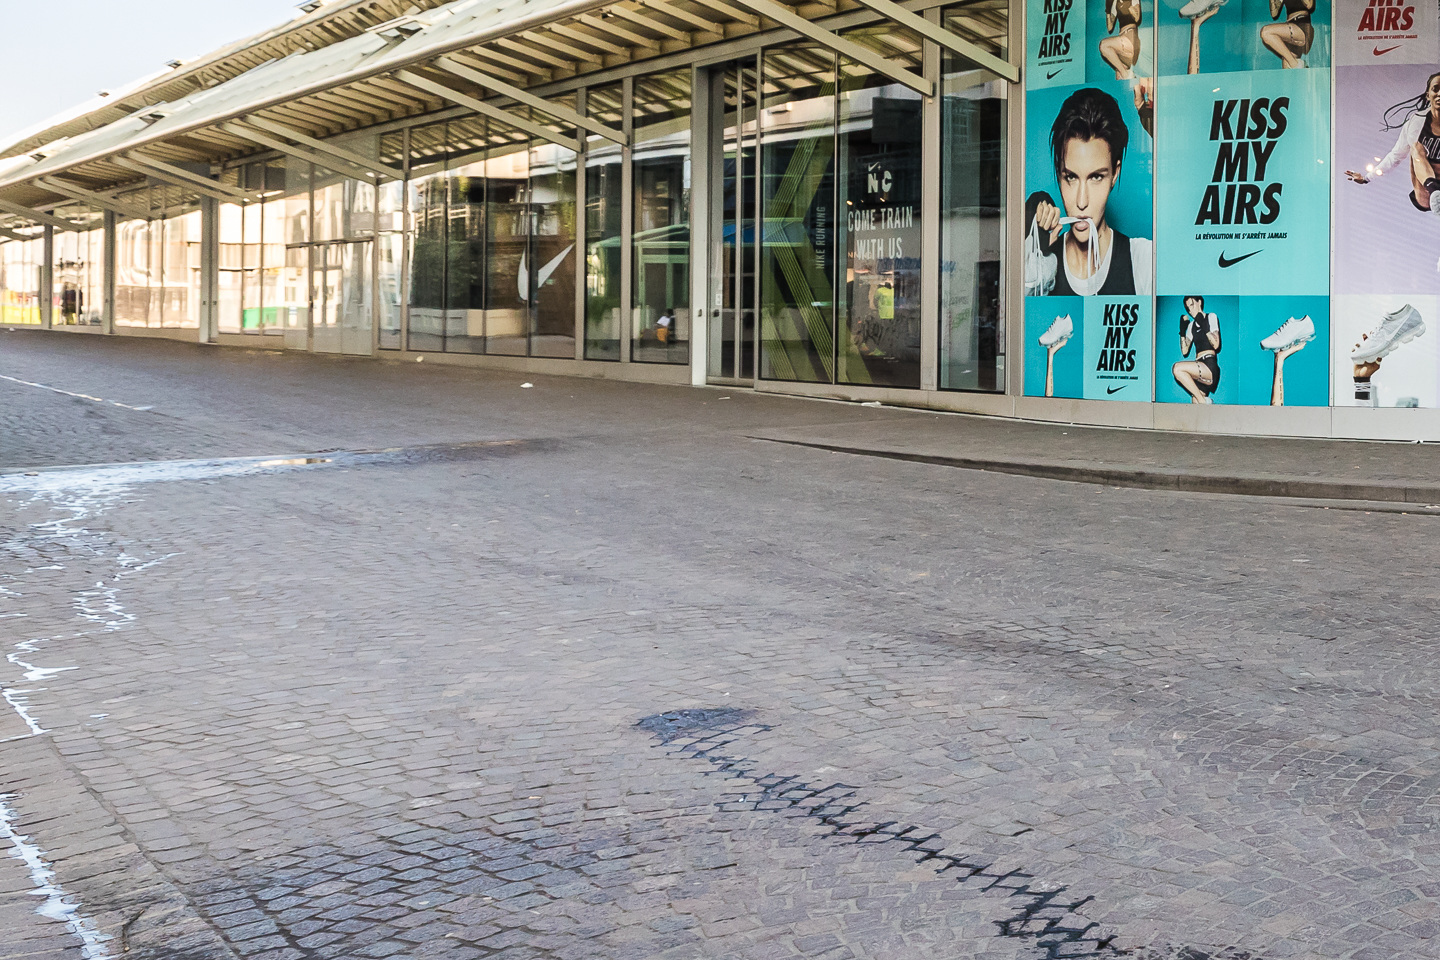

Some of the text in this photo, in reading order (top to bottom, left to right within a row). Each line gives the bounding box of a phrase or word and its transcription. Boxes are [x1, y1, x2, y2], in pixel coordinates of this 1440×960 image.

[1044, 11, 1069, 35] MY
[1357, 6, 1415, 32] AIRS
[1038, 33, 1071, 59] AIRS
[1210, 97, 1290, 141] KISS
[1212, 141, 1278, 182] MY
[1195, 183, 1282, 225] AIRS
[848, 206, 913, 232] COME TRAIN
[816, 206, 825, 269] NIKE RUNNING
[857, 238, 903, 260] WITH US
[1203, 232, 1233, 240] RÉVOLUTION
[1102, 304, 1139, 326] KISS
[1104, 327, 1133, 349] MY
[1096, 349, 1136, 372] AIRS
